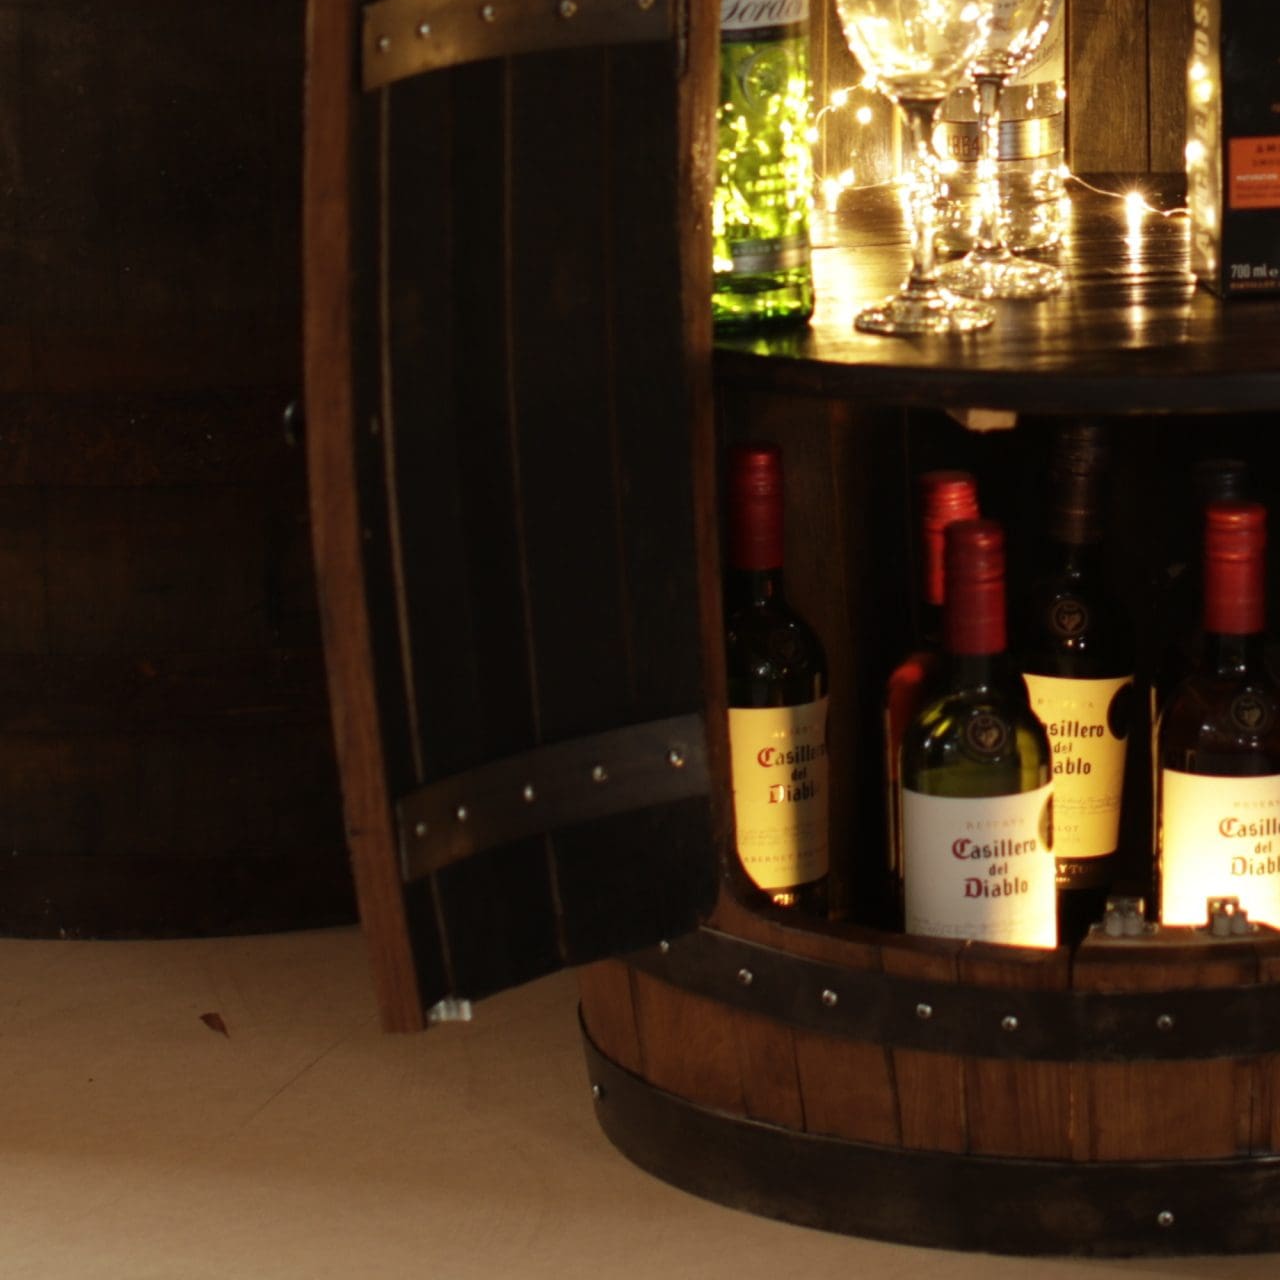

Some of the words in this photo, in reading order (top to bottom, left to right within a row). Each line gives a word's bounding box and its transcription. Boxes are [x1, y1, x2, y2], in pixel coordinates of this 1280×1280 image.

[1230, 264, 1250, 278] 700
[1252, 263, 1267, 277] ml
[1045, 719, 1104, 738] sillero
[1054, 741, 1073, 754] del
[952, 837, 1036, 860] Casillero
[1254, 841, 1272, 854] del
[988, 863, 1008, 876] del
[964, 877, 1029, 898] Diablo
